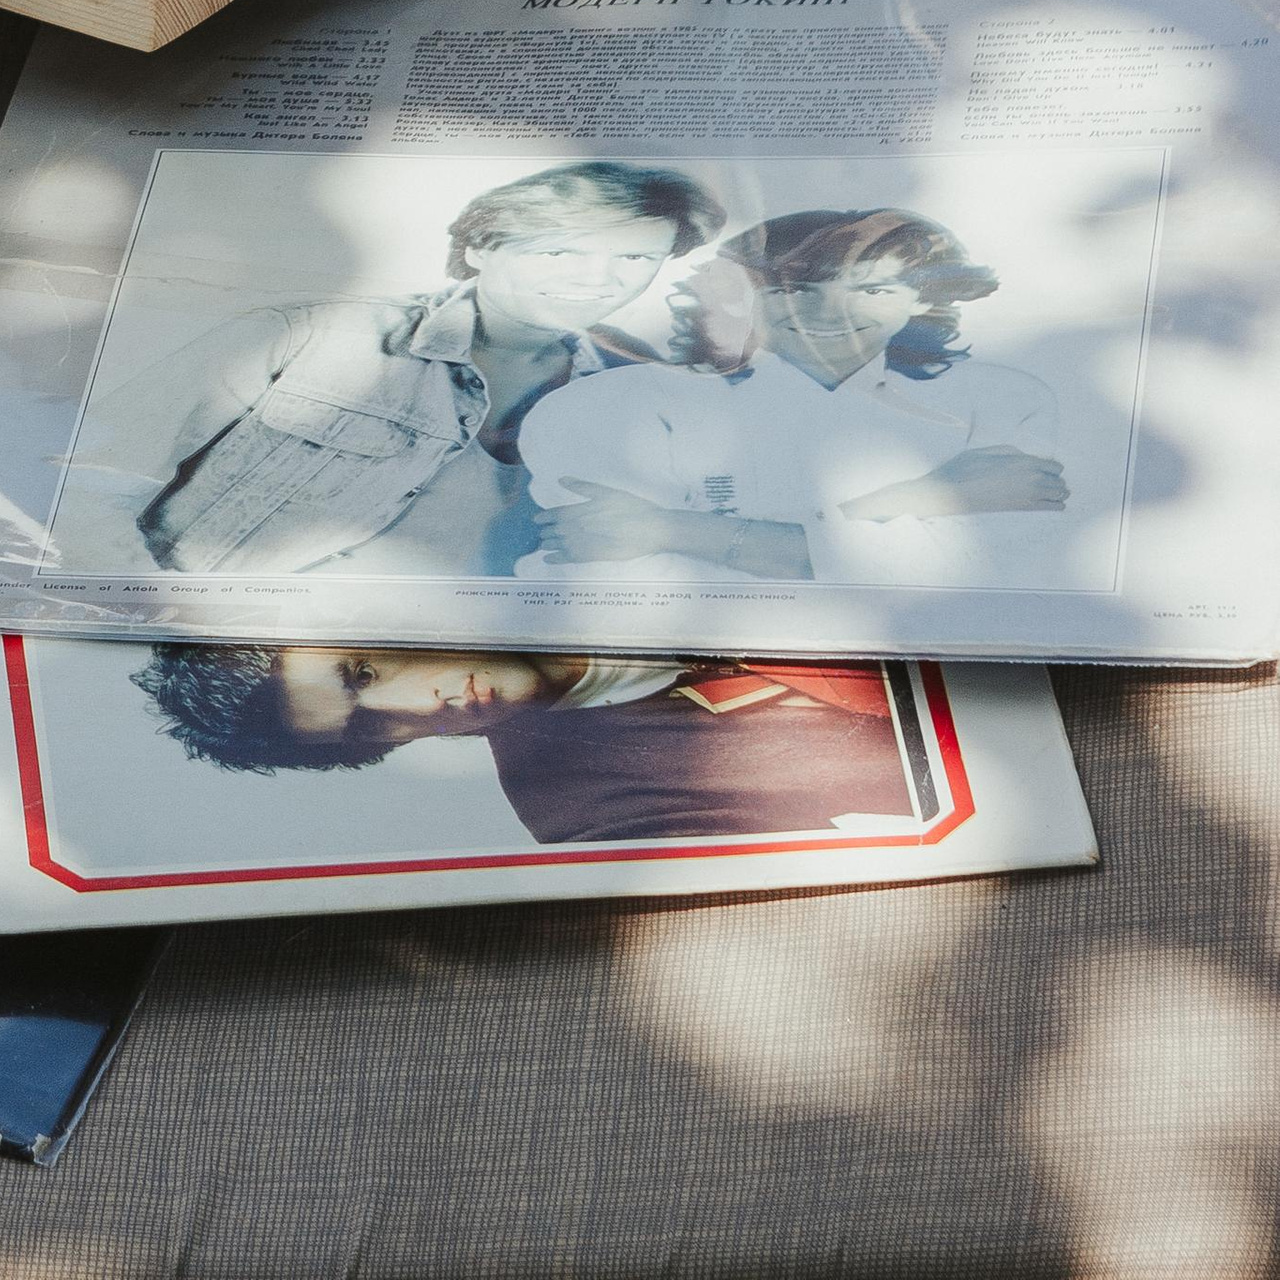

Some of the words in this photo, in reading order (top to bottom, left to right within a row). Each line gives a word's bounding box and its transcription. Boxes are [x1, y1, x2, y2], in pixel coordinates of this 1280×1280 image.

[42, 582, 87, 591] License
[98, 583, 112, 591] of
[122, 584, 159, 593] Ariola
[170, 584, 209, 595] Group
[516, 590, 562, 599] ОРДЕНА
[699, 591, 797, 601] ГРАМПЛАСТИНОК
